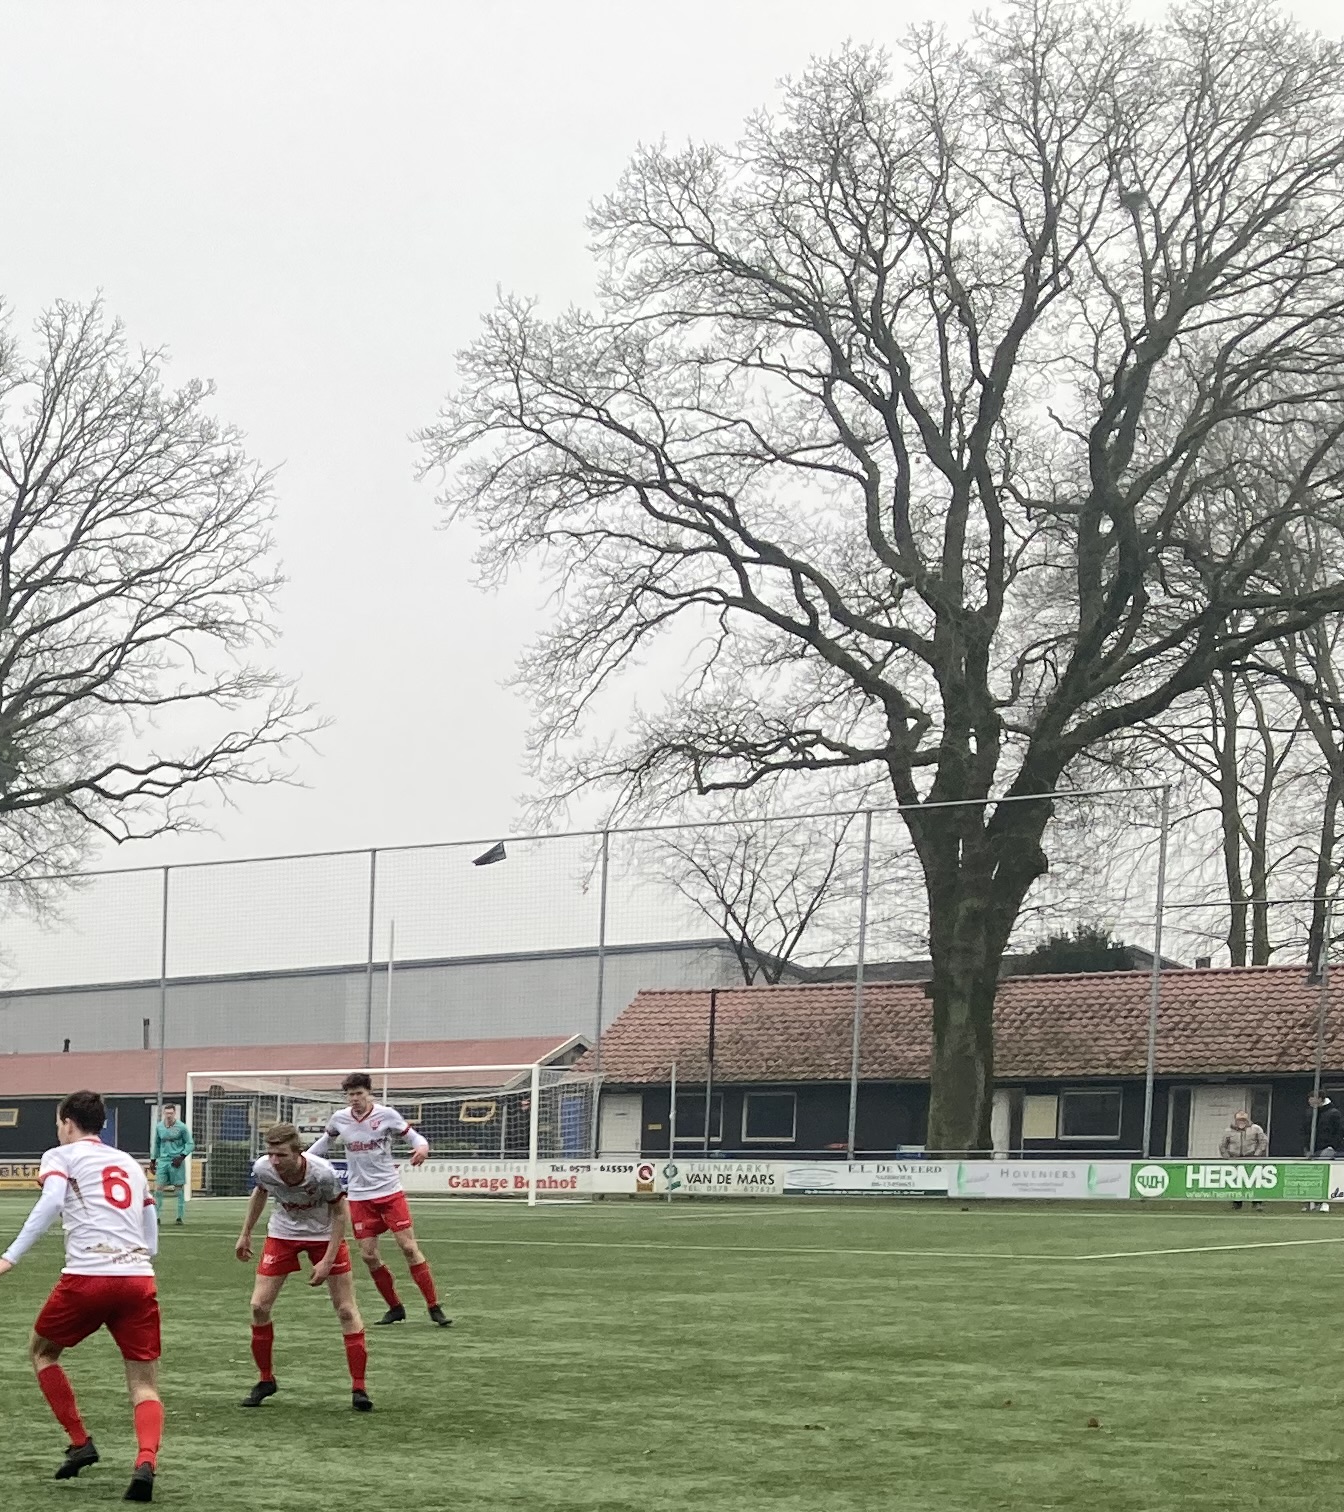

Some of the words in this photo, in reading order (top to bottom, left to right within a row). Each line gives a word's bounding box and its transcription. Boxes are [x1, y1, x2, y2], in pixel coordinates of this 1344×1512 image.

[690, 1164, 770, 1172] TUINMARKT
[1000, 1168, 1076, 1179] HOVENIERS
[448, 1175, 508, 1191] Garage
[686, 1174, 712, 1184] VAN
[716, 1174, 731, 1184] DE
[737, 1174, 775, 1185] MARS
[1186, 1165, 1277, 1189] HERMS
[101, 1165, 132, 1209] 6
